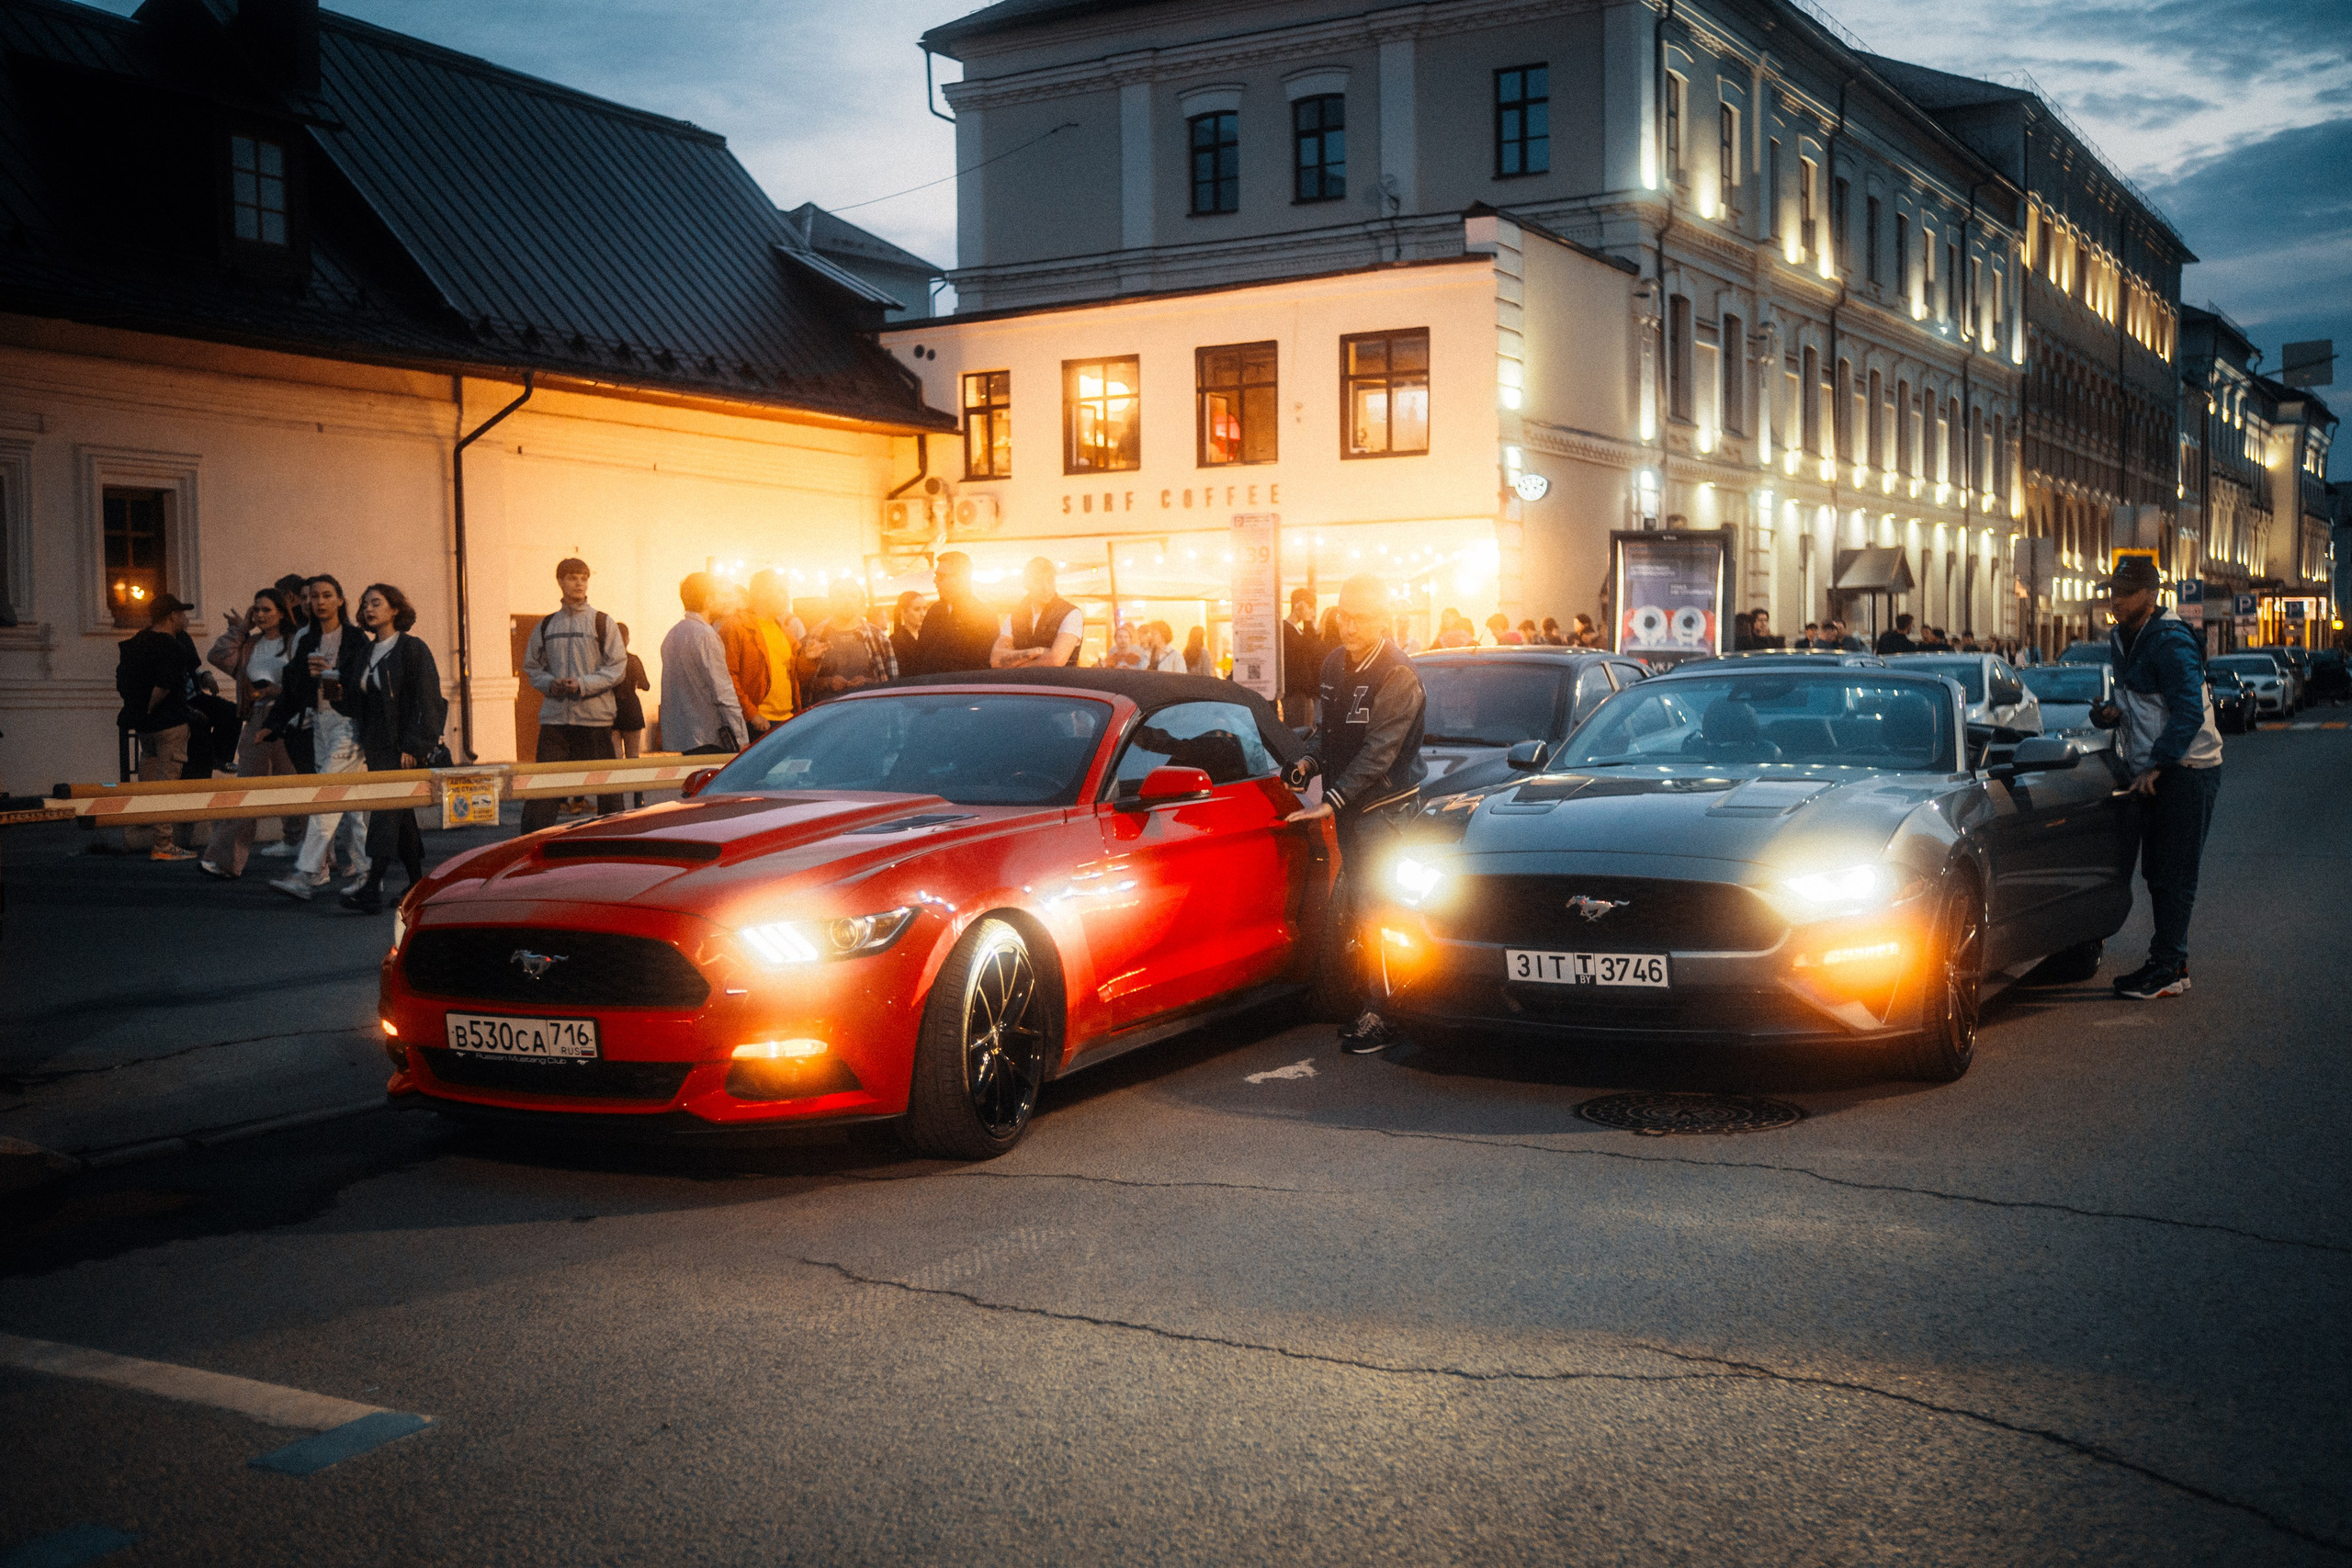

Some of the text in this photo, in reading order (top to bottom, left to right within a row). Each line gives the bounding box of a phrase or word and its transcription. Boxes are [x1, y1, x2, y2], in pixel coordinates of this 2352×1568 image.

[1063, 484, 1279, 514] SURF COFFEE
[2182, 581, 2197, 602] P
[2239, 595, 2252, 614] P
[1346, 685, 1370, 724] L
[1579, 975, 1591, 984] BY
[549, 1022, 590, 1046] 716
[508, 1055, 547, 1065] Mustang
[547, 1056, 567, 1065] Club
[560, 1046, 581, 1055] RUS
